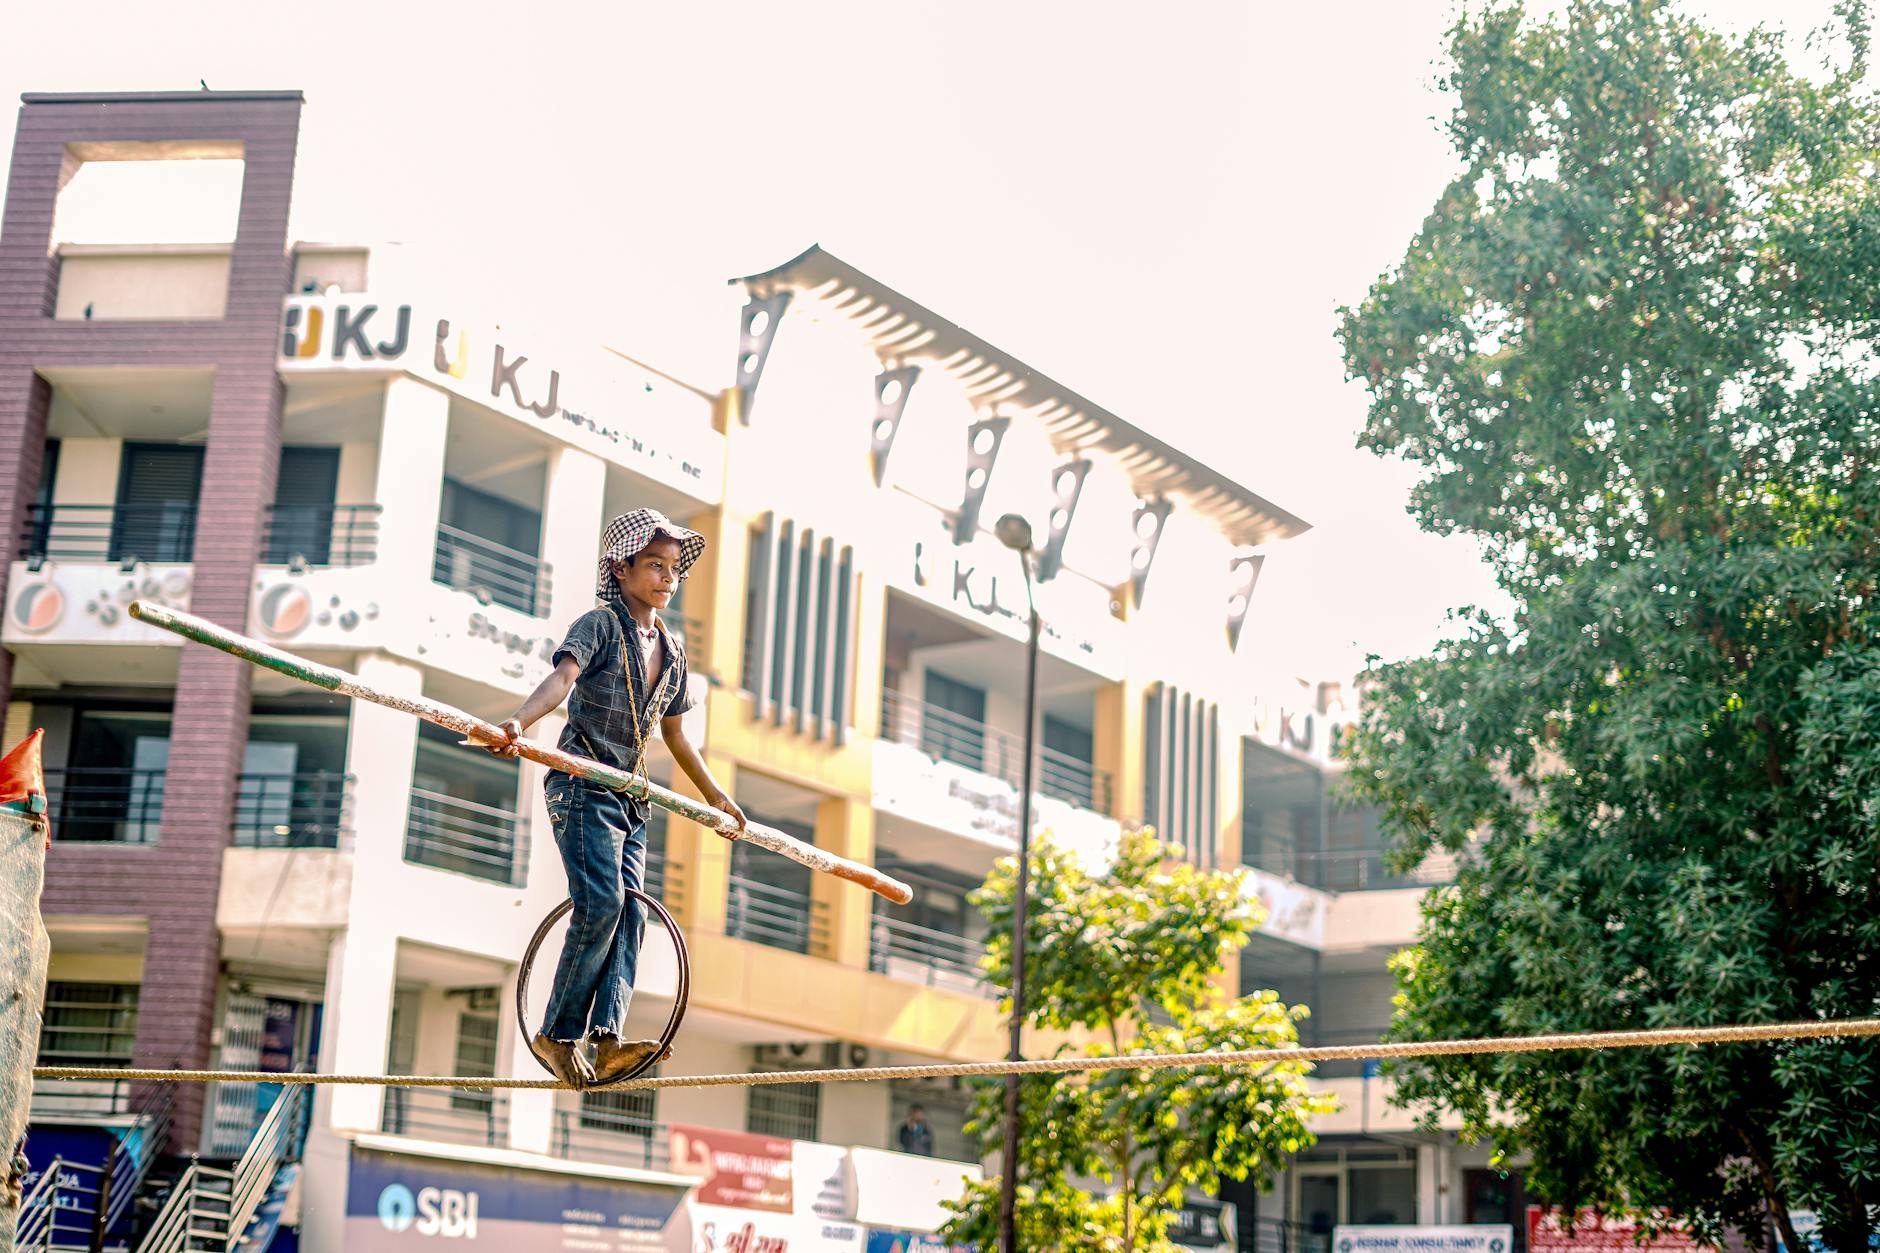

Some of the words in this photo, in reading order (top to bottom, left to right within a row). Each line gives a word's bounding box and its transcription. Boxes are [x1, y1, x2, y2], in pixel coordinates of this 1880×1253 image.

[331, 304, 412, 360] KJ
[491, 344, 560, 419] KJ
[954, 560, 997, 615] KJ
[416, 1187, 479, 1239] SBI
